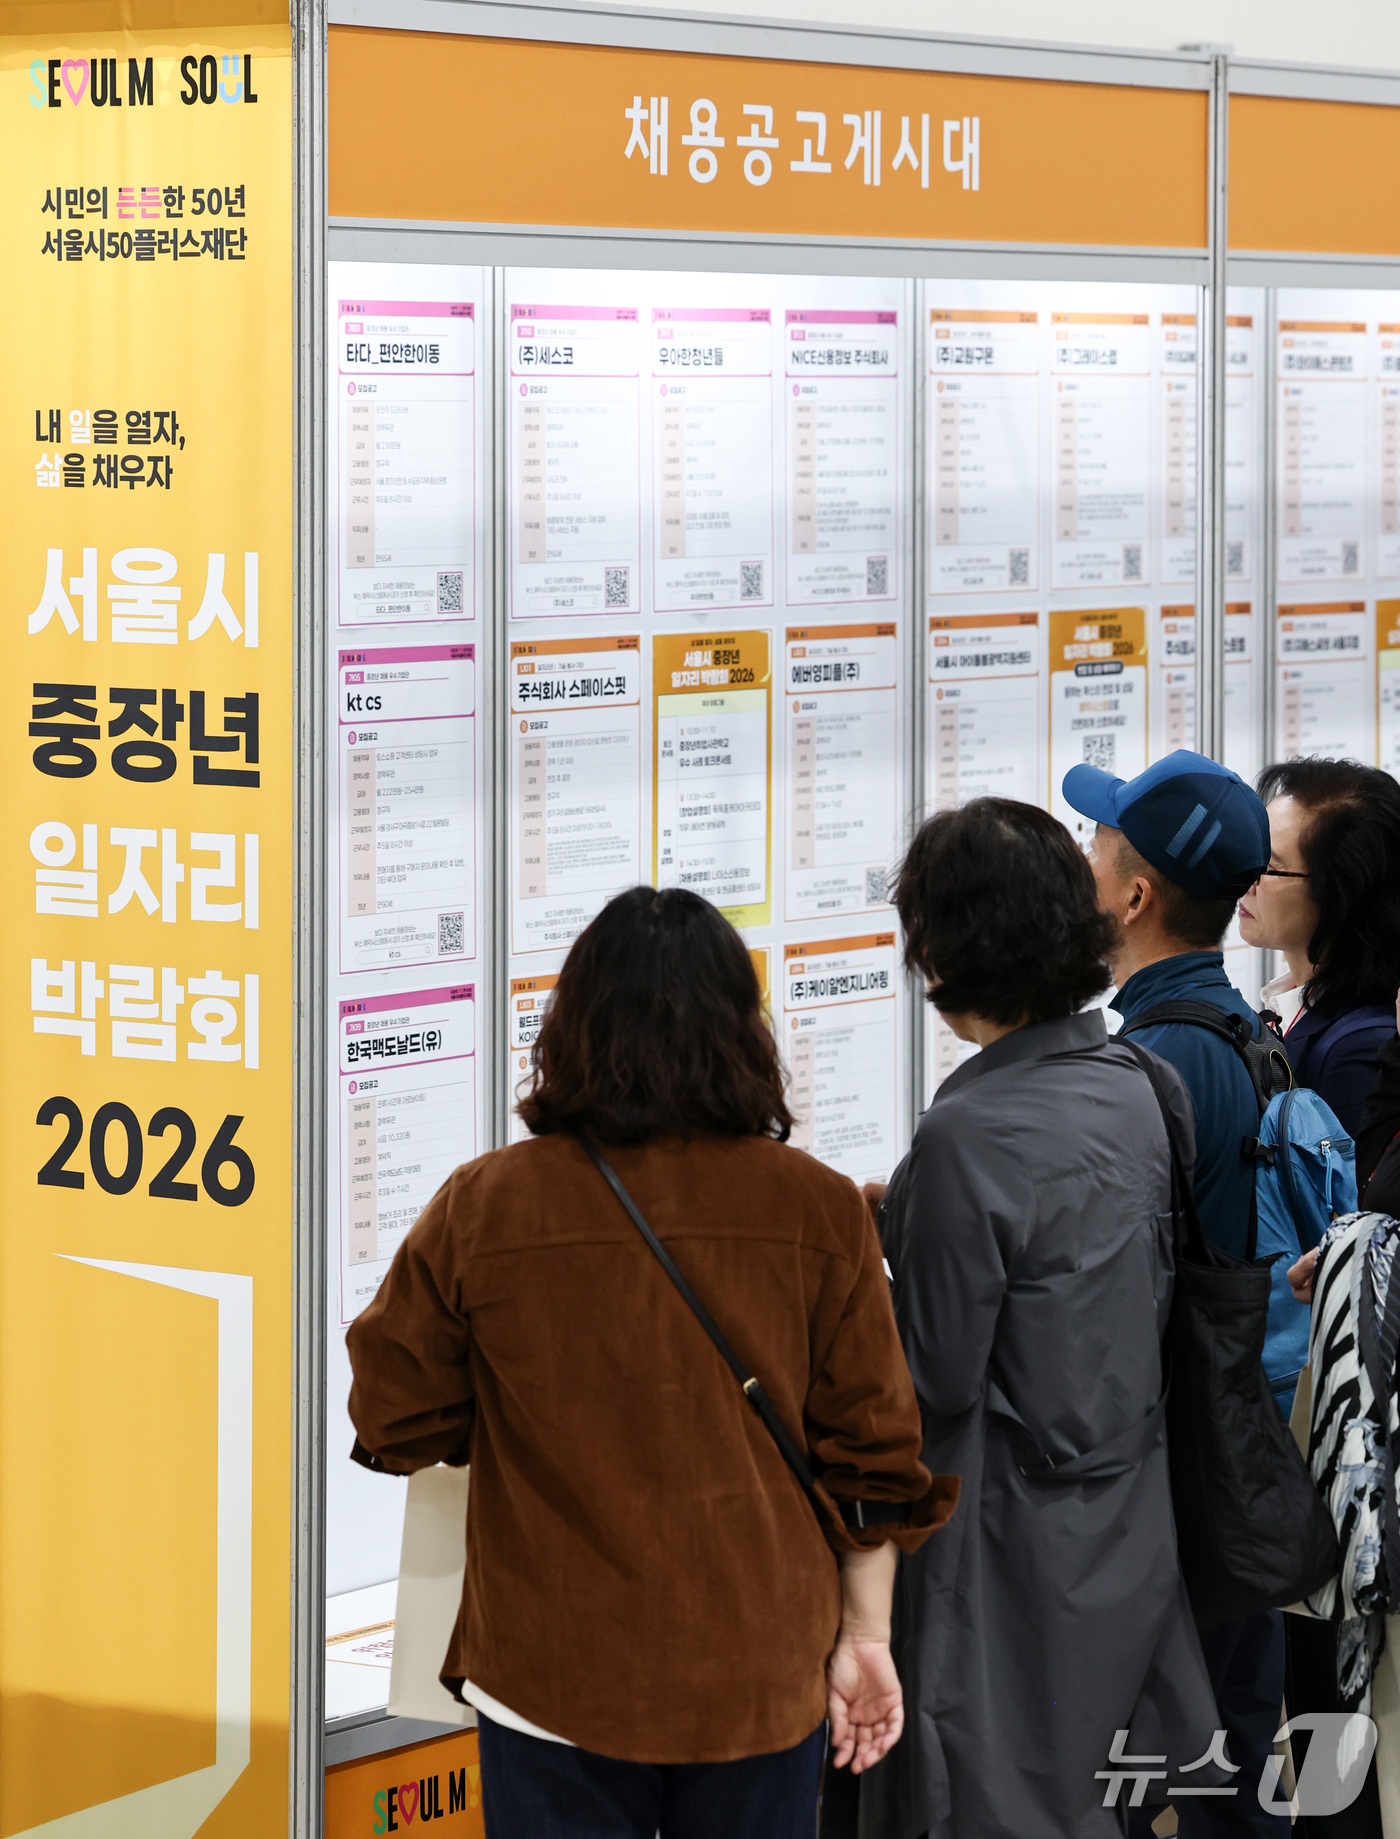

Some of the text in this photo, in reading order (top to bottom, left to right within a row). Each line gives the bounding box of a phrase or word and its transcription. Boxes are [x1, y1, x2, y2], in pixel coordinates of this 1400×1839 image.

[624, 95, 980, 191] 채용공고게시대
[41, 185, 246, 219] 시민의 든든한 50년
[41, 228, 247, 261] 서울시50플러스재단
[346, 343, 440, 365] 타다_편안한이동
[519, 345, 574, 365] (주)세스코
[659, 348, 723, 366] 우아한청년들
[792, 350, 889, 365] NICE신용정보 주식회사
[358, 384, 377, 393] 모집공고
[36, 410, 186, 450] 내 일을 열자,
[35, 453, 173, 490] 삶을 채우자
[28, 547, 259, 648] 서울시
[684, 649, 740, 667] 서울시 중장년
[518, 676, 626, 702] 주식회사 스페이스핏
[671, 670, 700, 687] 일자리
[730, 668, 755, 684] 2026
[347, 692, 382, 712] kt cs
[28, 683, 260, 788] 중장년
[358, 732, 378, 741] 모집공고
[529, 721, 548, 730] 모집공고
[29, 821, 259, 929] 일자리
[388, 950, 394, 958] kt
[791, 970, 889, 1002] (주)케이알엔지니어링
[31, 958, 259, 1070] 박람회
[347, 1029, 442, 1063] 한국맥도날드(유)
[359, 1080, 379, 1090] 모집공고
[36, 1096, 255, 1207] 2026
